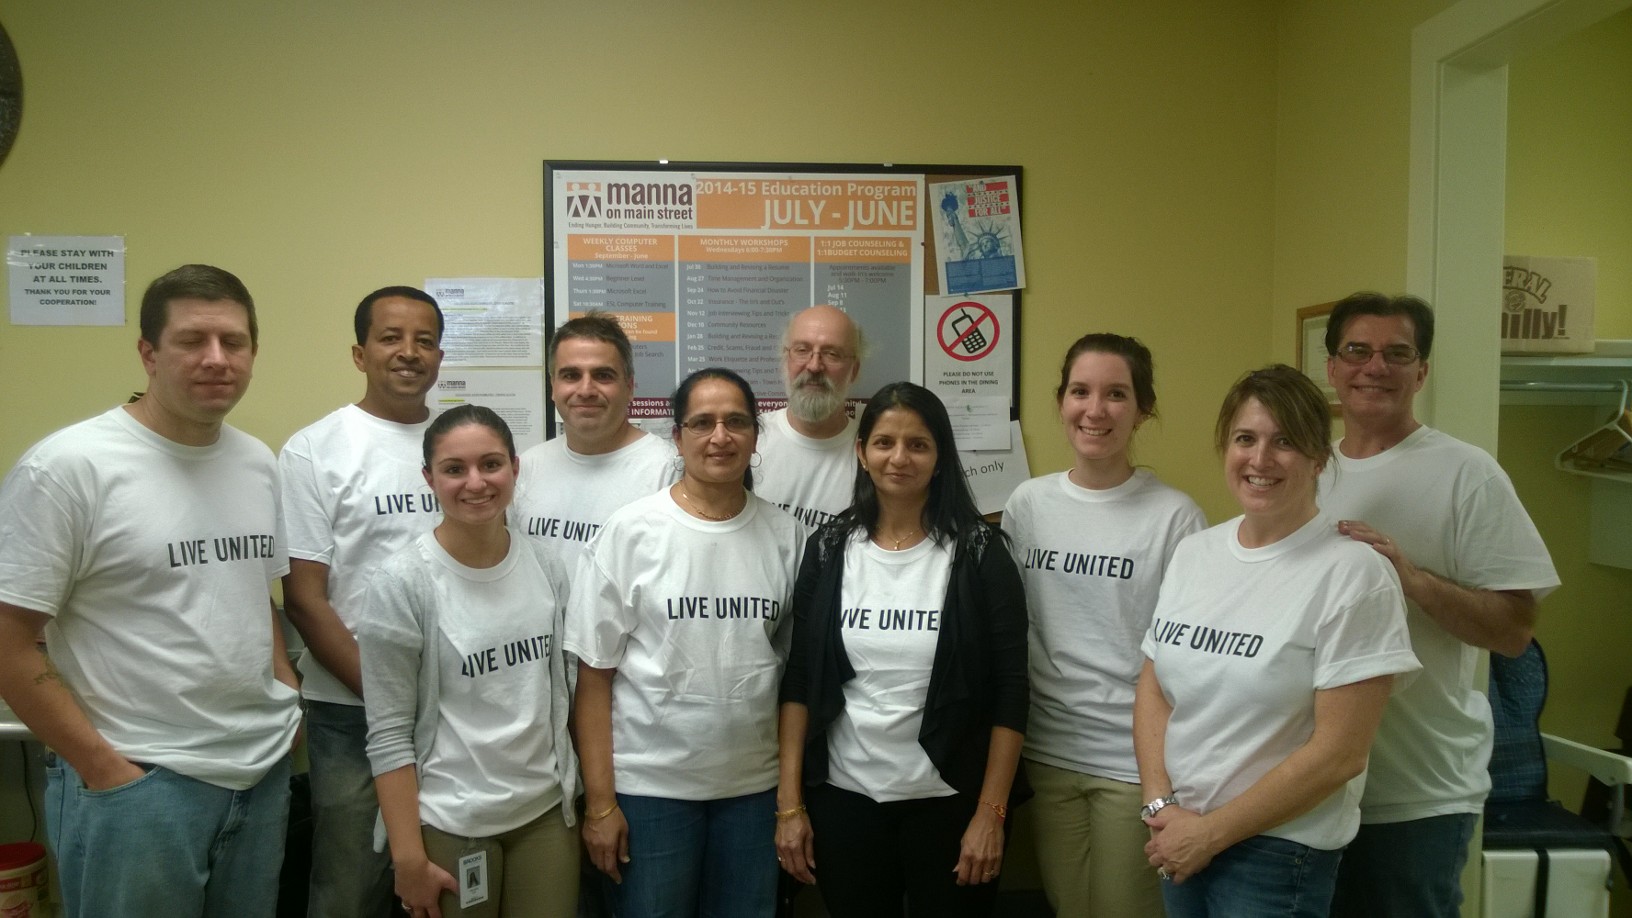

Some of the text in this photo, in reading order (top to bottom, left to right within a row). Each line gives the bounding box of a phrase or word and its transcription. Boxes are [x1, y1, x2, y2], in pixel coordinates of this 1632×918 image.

[608, 183, 692, 206] manna
[696, 181, 916, 199] 2014-15 Education Program
[606, 206, 692, 220] on main street
[761, 200, 826, 230] JULY
[844, 200, 914, 230] JUNE
[832, 240, 846, 248] JOB
[980, 461, 1004, 474] only
[375, 494, 416, 515] LIVE
[528, 517, 602, 542] LIVE UNIT
[168, 535, 274, 568] LIVE UNITED
[1025, 549, 1134, 579] LIVE UNITED
[668, 597, 780, 621] LIVE UNITED
[841, 608, 939, 631] IVE UNITE
[1155, 618, 1264, 658] LIVE UNITED
[462, 648, 498, 678] LIVE
